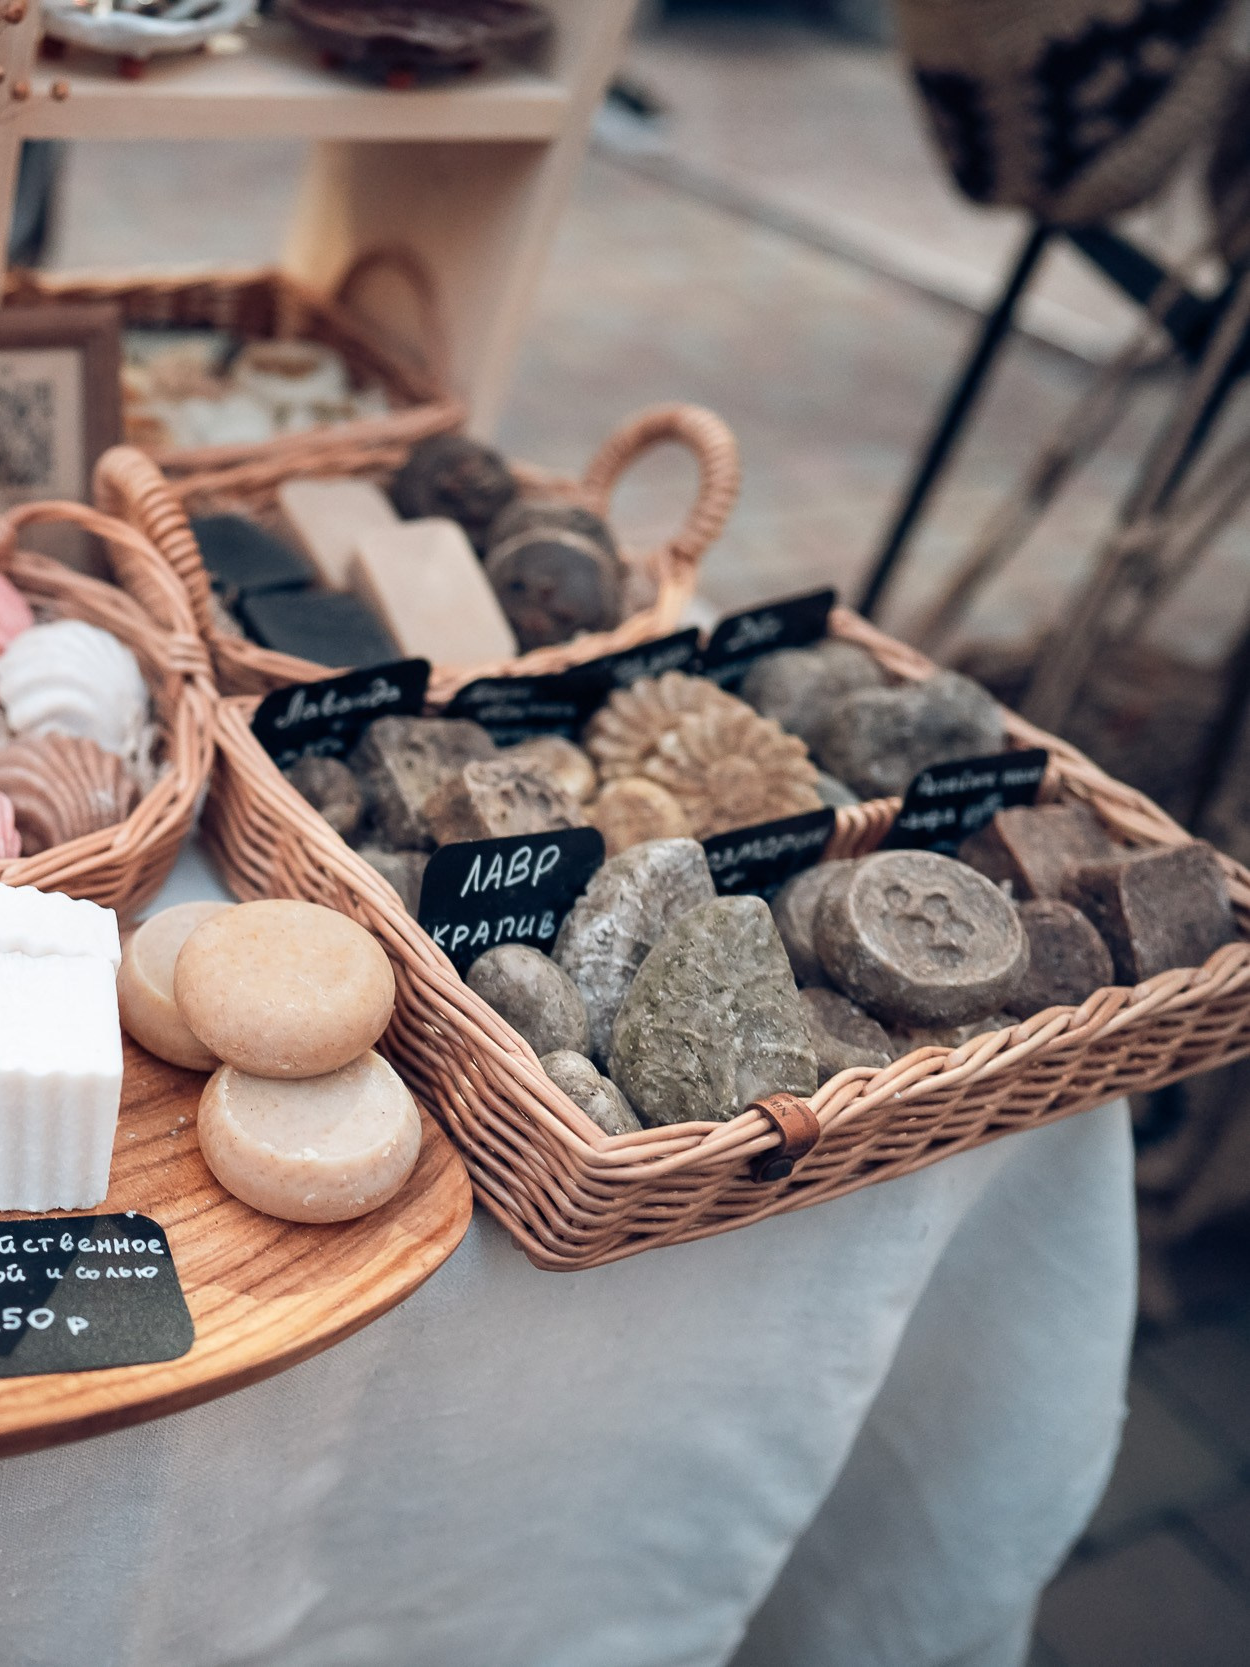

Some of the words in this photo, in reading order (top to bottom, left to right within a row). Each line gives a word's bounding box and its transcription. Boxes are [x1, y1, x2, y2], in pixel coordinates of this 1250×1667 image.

[459, 844, 561, 898] ЛАВР
[432, 910, 556, 952] КРАПИВ
[46, 1267, 64, 1280] и
[75, 1265, 160, 1281] солью
